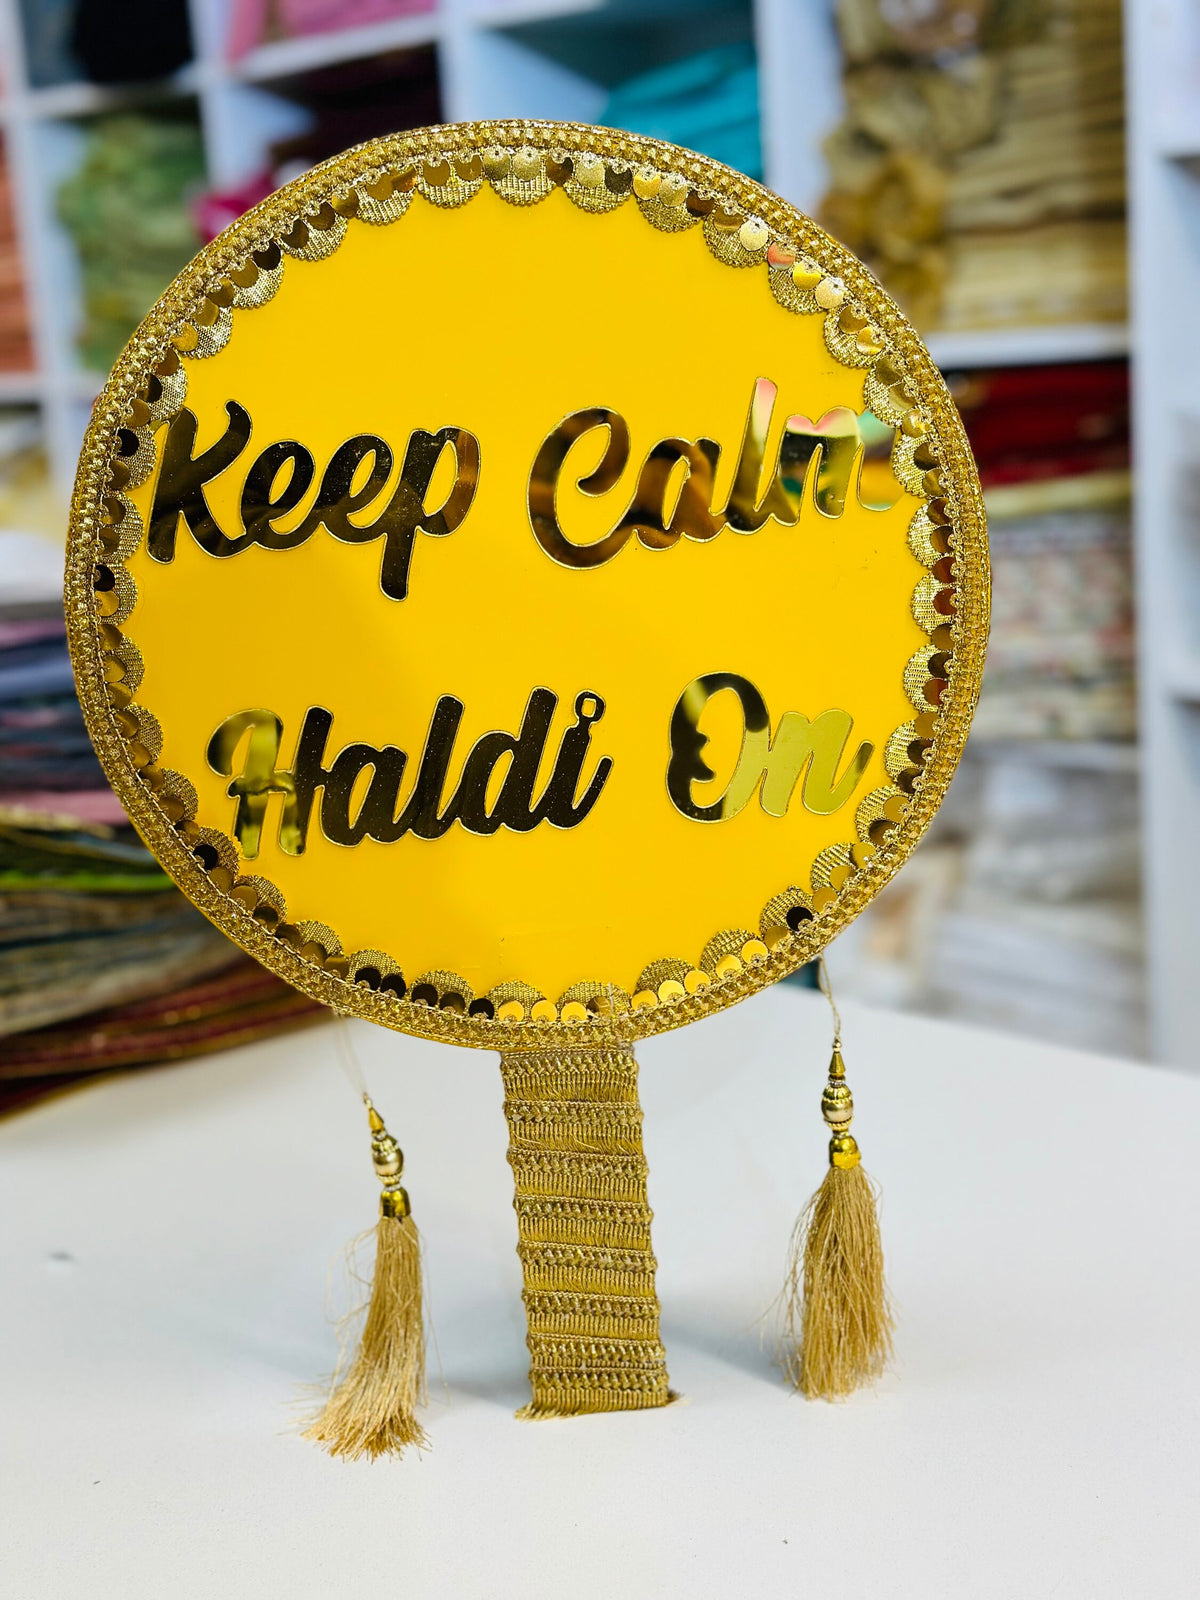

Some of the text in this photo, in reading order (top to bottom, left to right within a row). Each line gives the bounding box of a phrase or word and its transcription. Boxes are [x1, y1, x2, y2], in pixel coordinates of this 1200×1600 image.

[147, 376, 904, 602] Keep Calm
[206, 670, 875, 860] Haldi On
